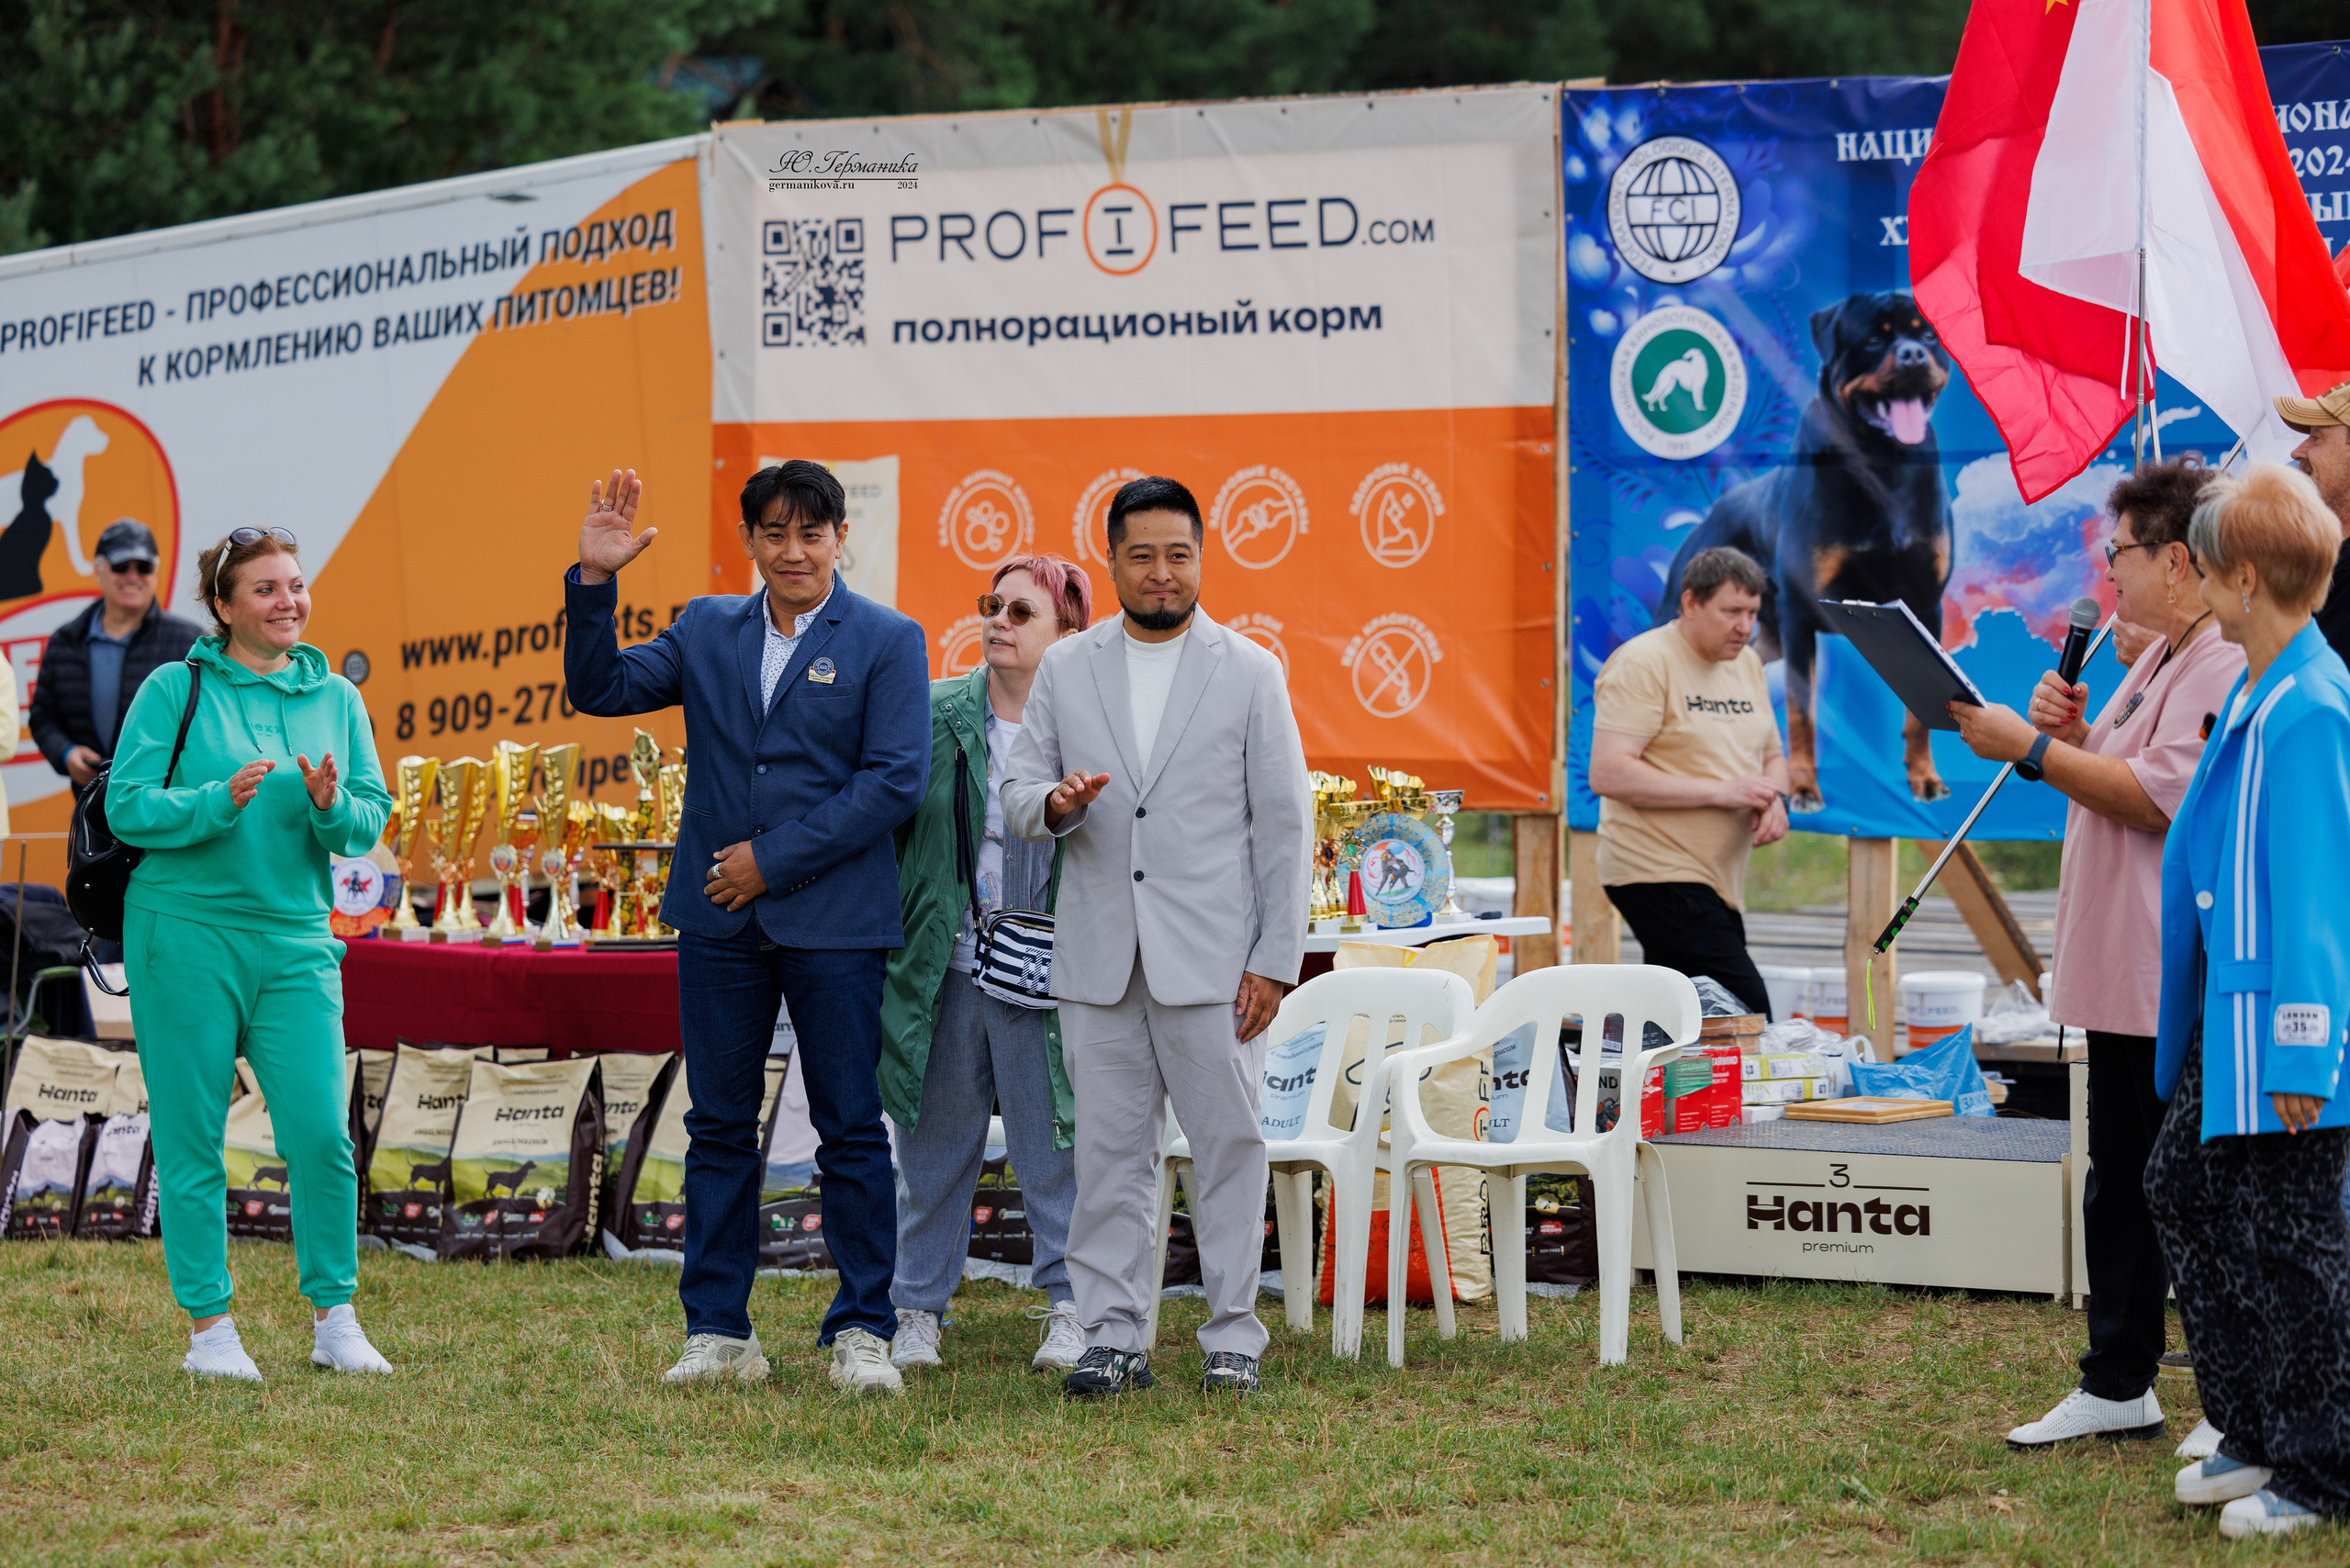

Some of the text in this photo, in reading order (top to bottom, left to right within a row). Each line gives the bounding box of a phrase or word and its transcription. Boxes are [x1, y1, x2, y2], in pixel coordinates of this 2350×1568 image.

[1836, 128, 1934, 166] НАЦИ
[2289, 145, 2350, 177] 202
[1651, 198, 1696, 223] FCI
[0, 300, 155, 353] PROFIFEED
[186, 226, 531, 323] ПРОФЕССИОНАЛЬНЫЙ
[541, 208, 676, 264] ПОДХОД
[138, 266, 681, 387] К КОРМЛЕНИЮ ВАШИХ ПИТОМЦЕВ!
[1270, 304, 1383, 339] корм
[1685, 695, 1754, 714] Hanta
[396, 702, 415, 740] 8
[1263, 1067, 1316, 1092] ant
[39, 1082, 99, 1103] Hanta
[418, 1092, 465, 1109] Hant
[1270, 1090, 1305, 1101] premium
[495, 1104, 565, 1121] Hanta
[1261, 1115, 1302, 1128] ADULT
[1829, 1162, 1851, 1189] 3
[1747, 1194, 1930, 1237] Hanta
[1802, 1239, 1874, 1254] premium
